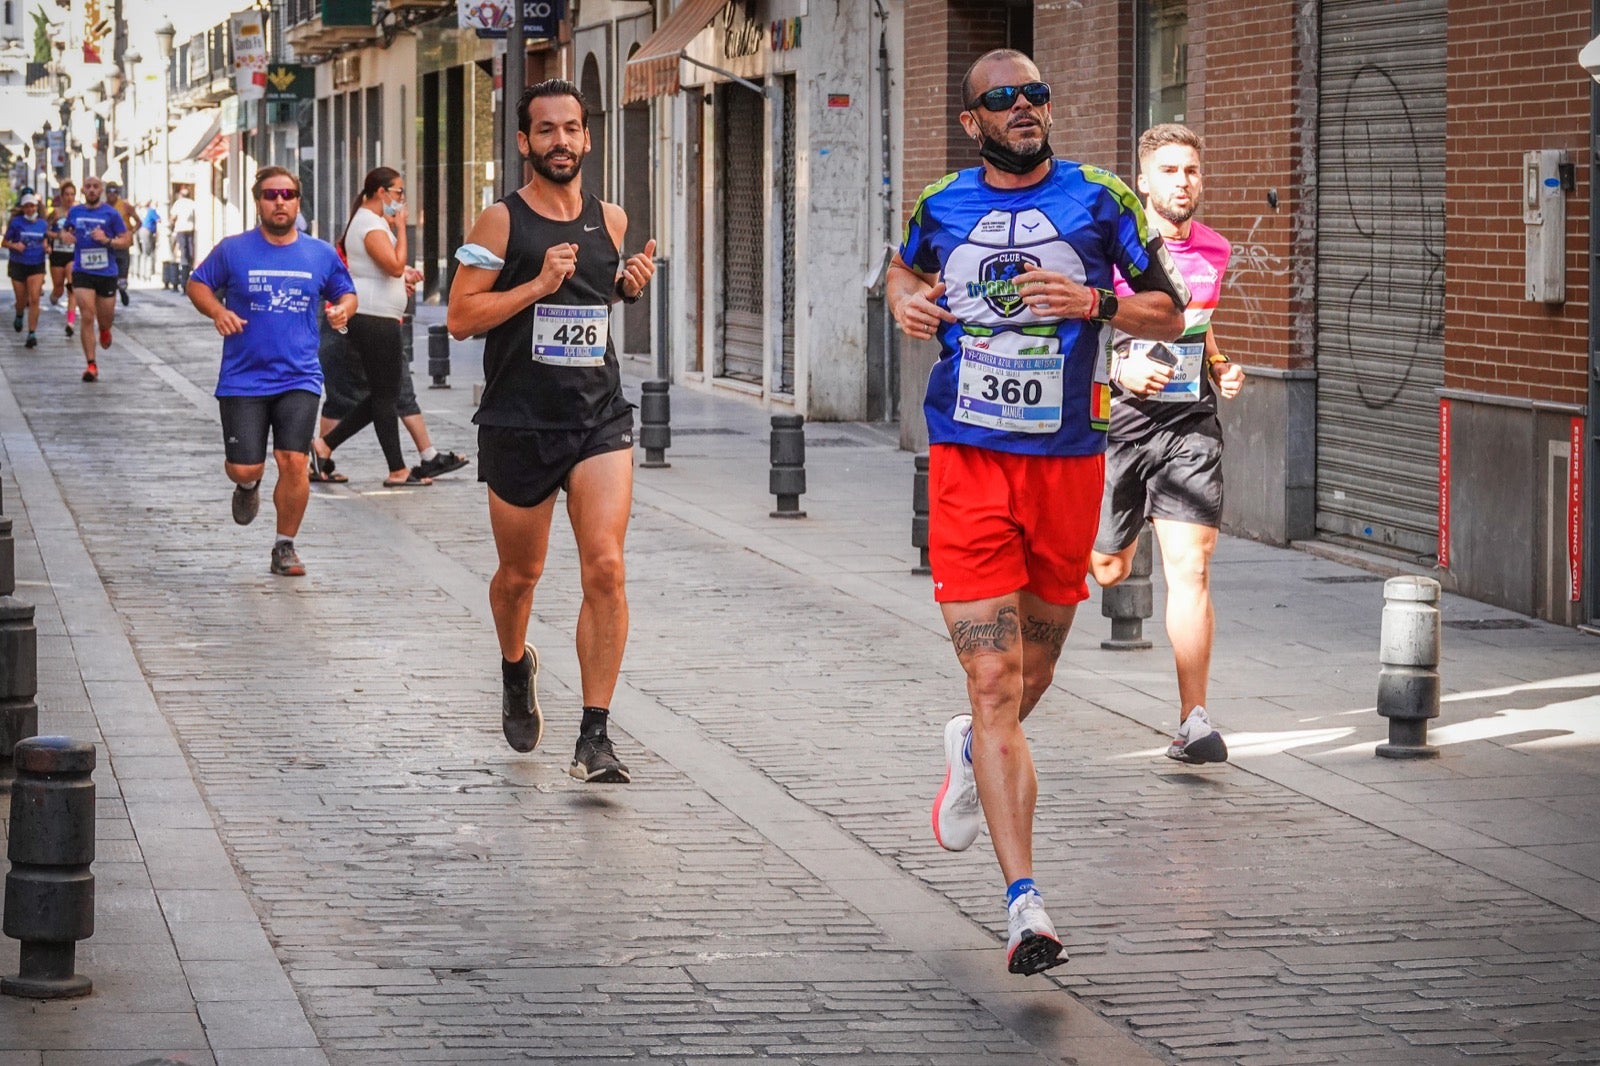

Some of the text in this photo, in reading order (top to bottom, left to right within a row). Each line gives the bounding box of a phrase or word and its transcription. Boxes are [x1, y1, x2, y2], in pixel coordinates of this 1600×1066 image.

[770, 16, 802, 52] COLOR
[999, 253, 1021, 262] CLUB
[553, 324, 597, 346] 426
[976, 352, 997, 365] CARRERA
[998, 358, 1012, 368] AZUL
[1013, 360, 1025, 369] POR
[1026, 360, 1032, 369] EL
[1034, 359, 1056, 369] AUTISMO
[981, 374, 1043, 405] 360
[1001, 405, 1025, 419] MANUEL
[1442, 461, 1447, 477] SU
[1573, 483, 1579, 502] SU
